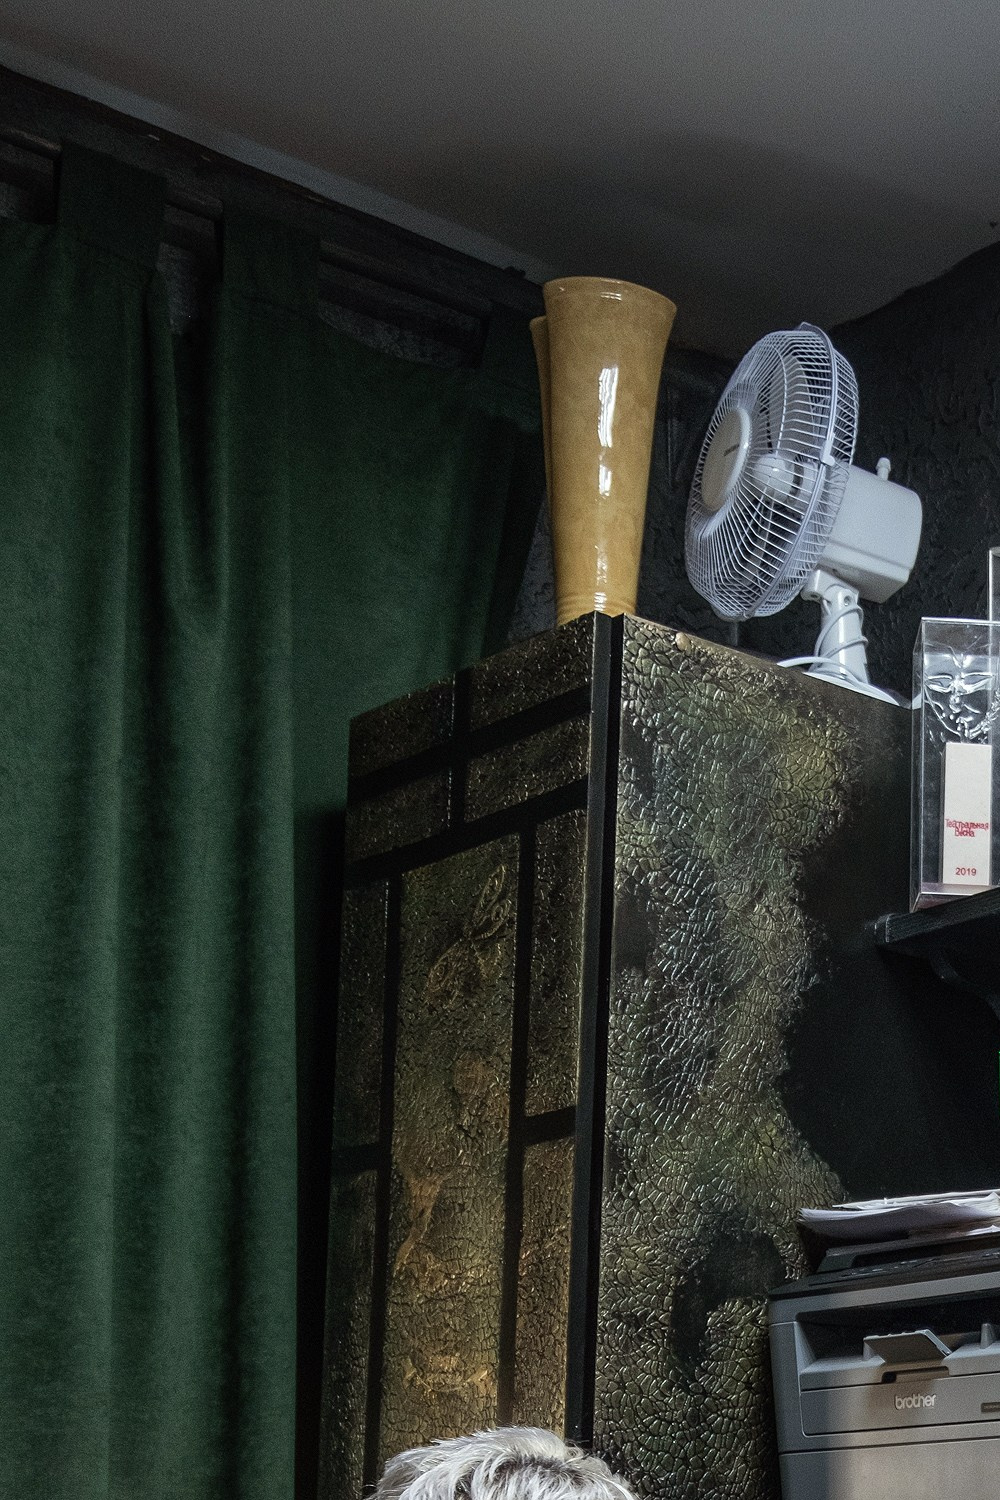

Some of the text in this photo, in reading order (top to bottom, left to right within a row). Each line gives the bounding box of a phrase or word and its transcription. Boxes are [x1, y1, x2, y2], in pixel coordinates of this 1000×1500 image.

[945, 819, 989, 831] Театральная
[955, 827, 975, 837] Весна
[956, 868, 976, 876] 2019
[895, 1394, 936, 1410] brother
